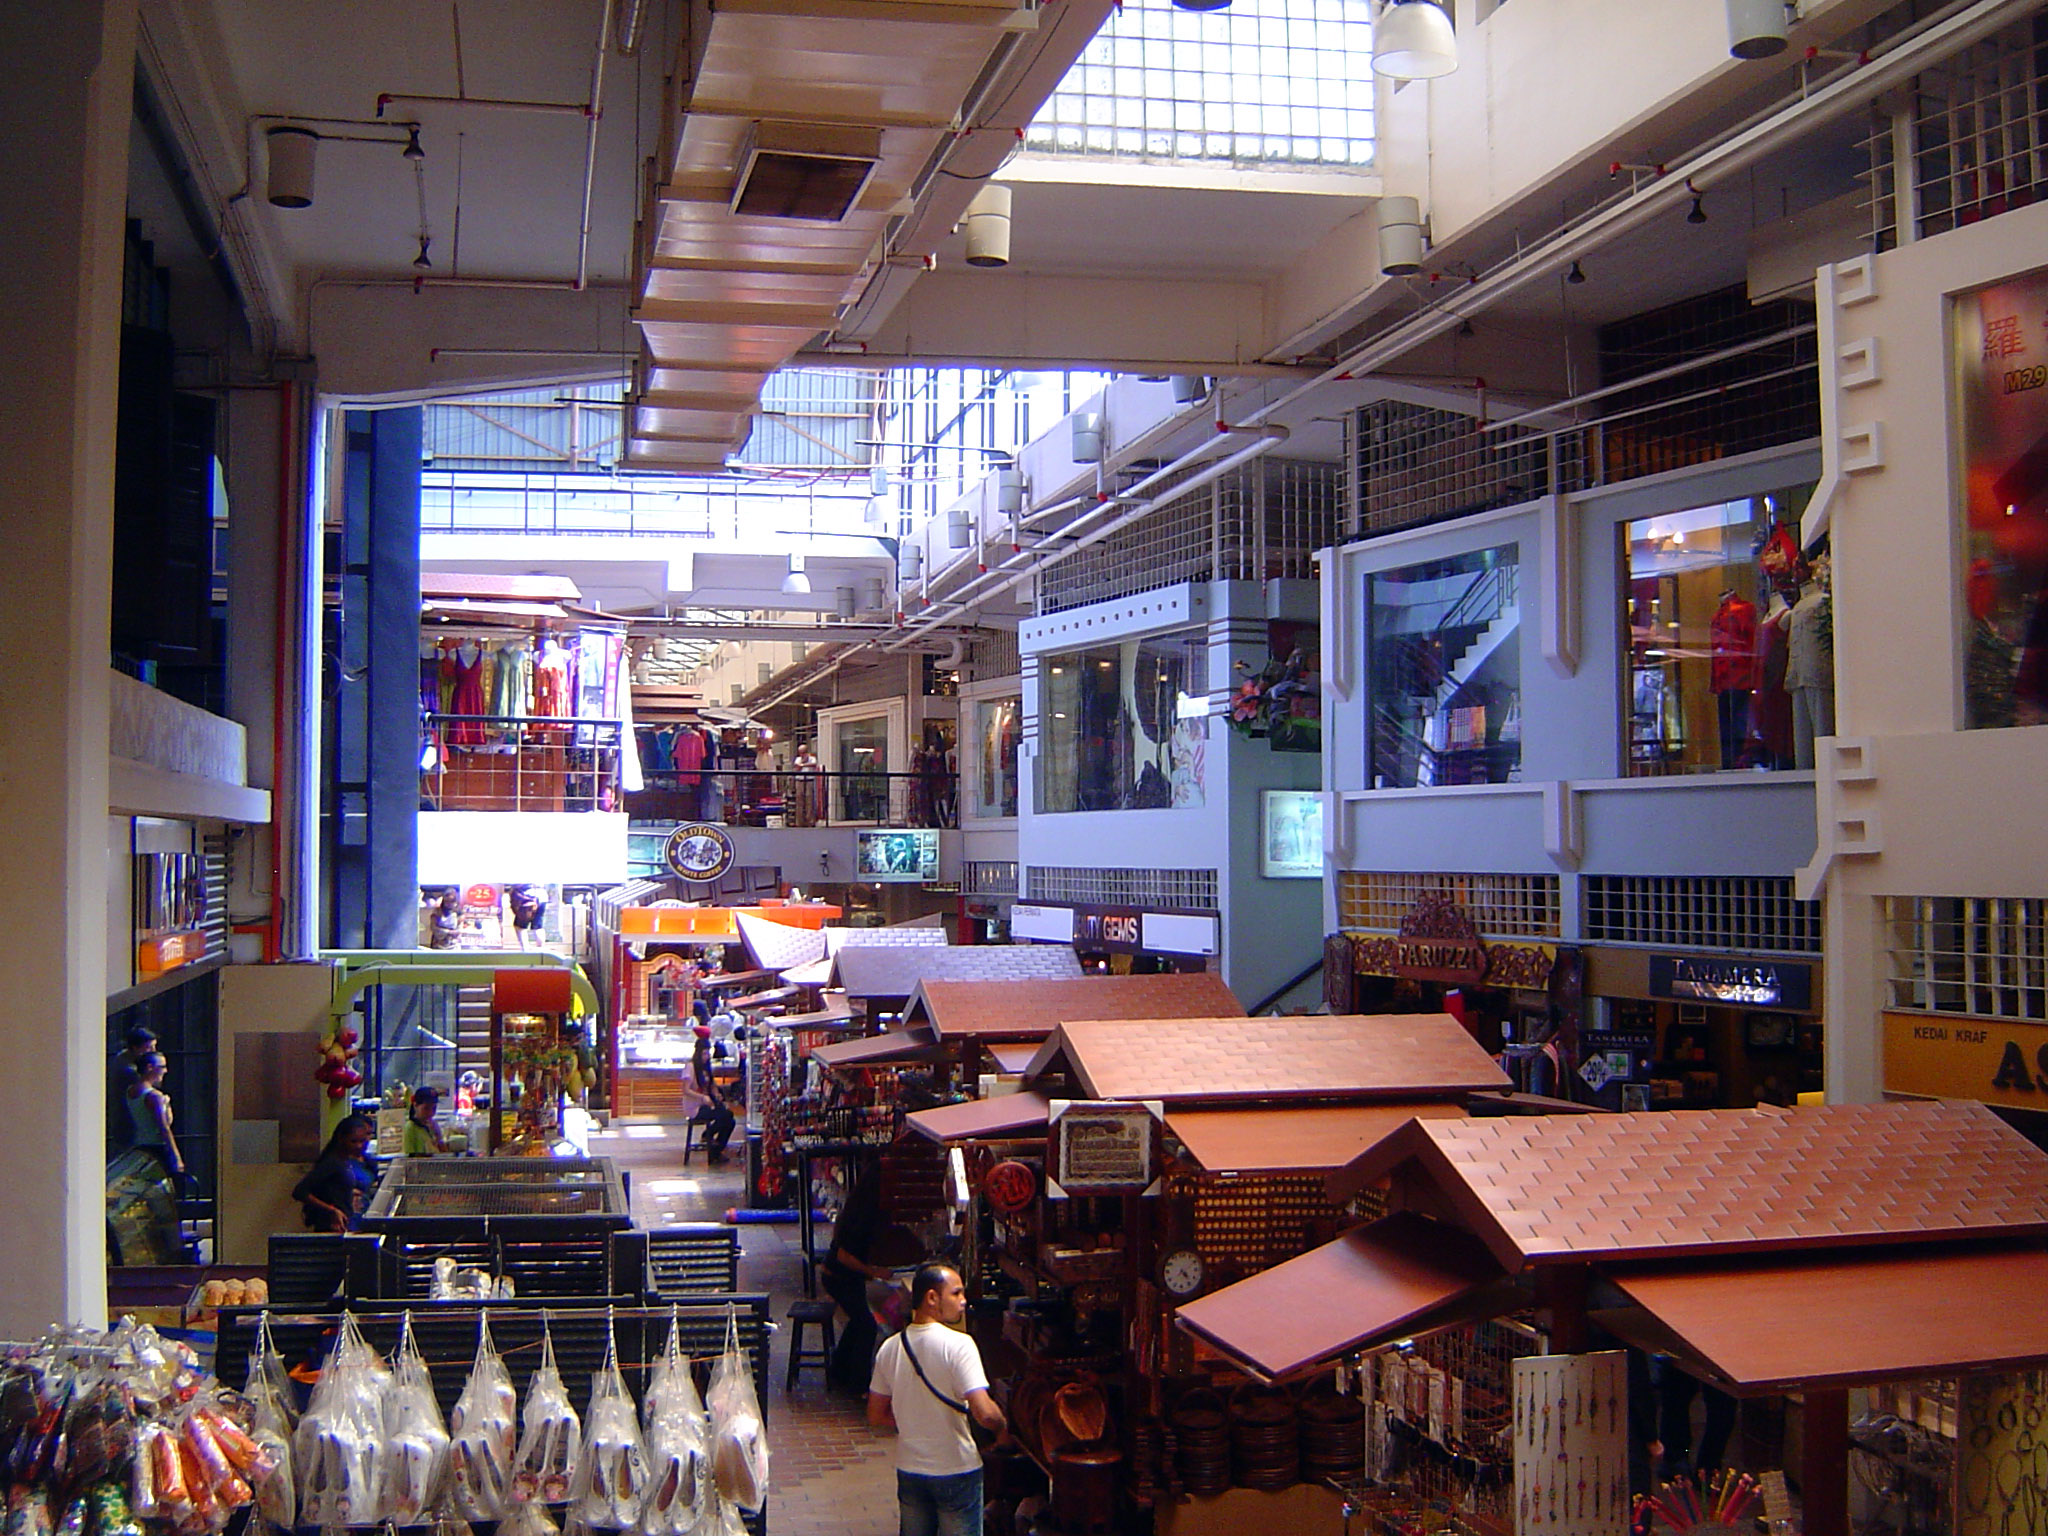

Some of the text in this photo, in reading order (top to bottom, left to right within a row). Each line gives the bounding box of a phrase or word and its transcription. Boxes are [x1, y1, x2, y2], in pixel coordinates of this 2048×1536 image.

[1984, 314, 2027, 360] 羅
[2003, 365, 2047, 395] M29
[1103, 915, 1138, 943] GEMS
[1398, 943, 1478, 969] FARUZZI
[1672, 959, 1781, 986] TANAMERA
[1914, 1026, 1988, 1044] KEDAI KRAF
